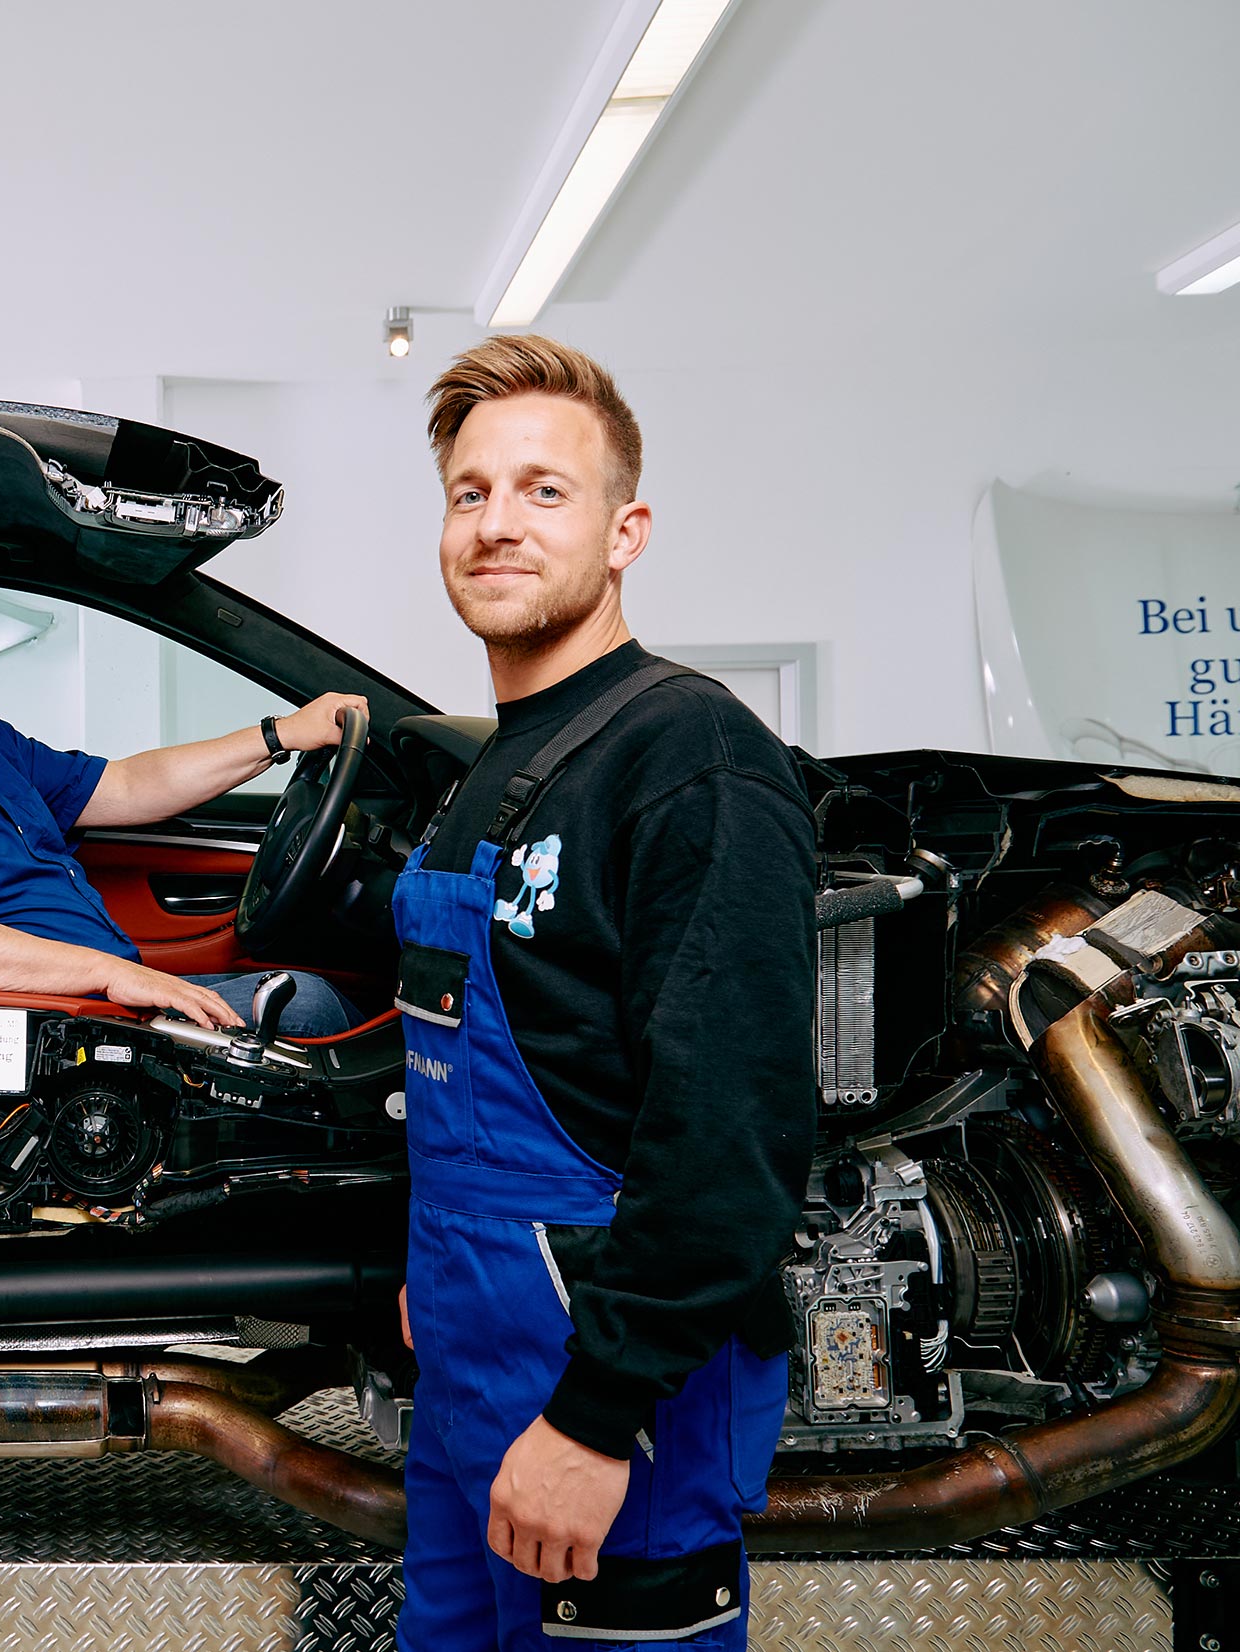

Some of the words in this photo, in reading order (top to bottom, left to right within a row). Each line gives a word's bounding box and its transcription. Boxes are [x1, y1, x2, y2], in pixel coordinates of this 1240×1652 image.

[1138, 596, 1212, 635] Bei
[1190, 658, 1240, 695] gu
[1165, 698, 1240, 737] Hä
